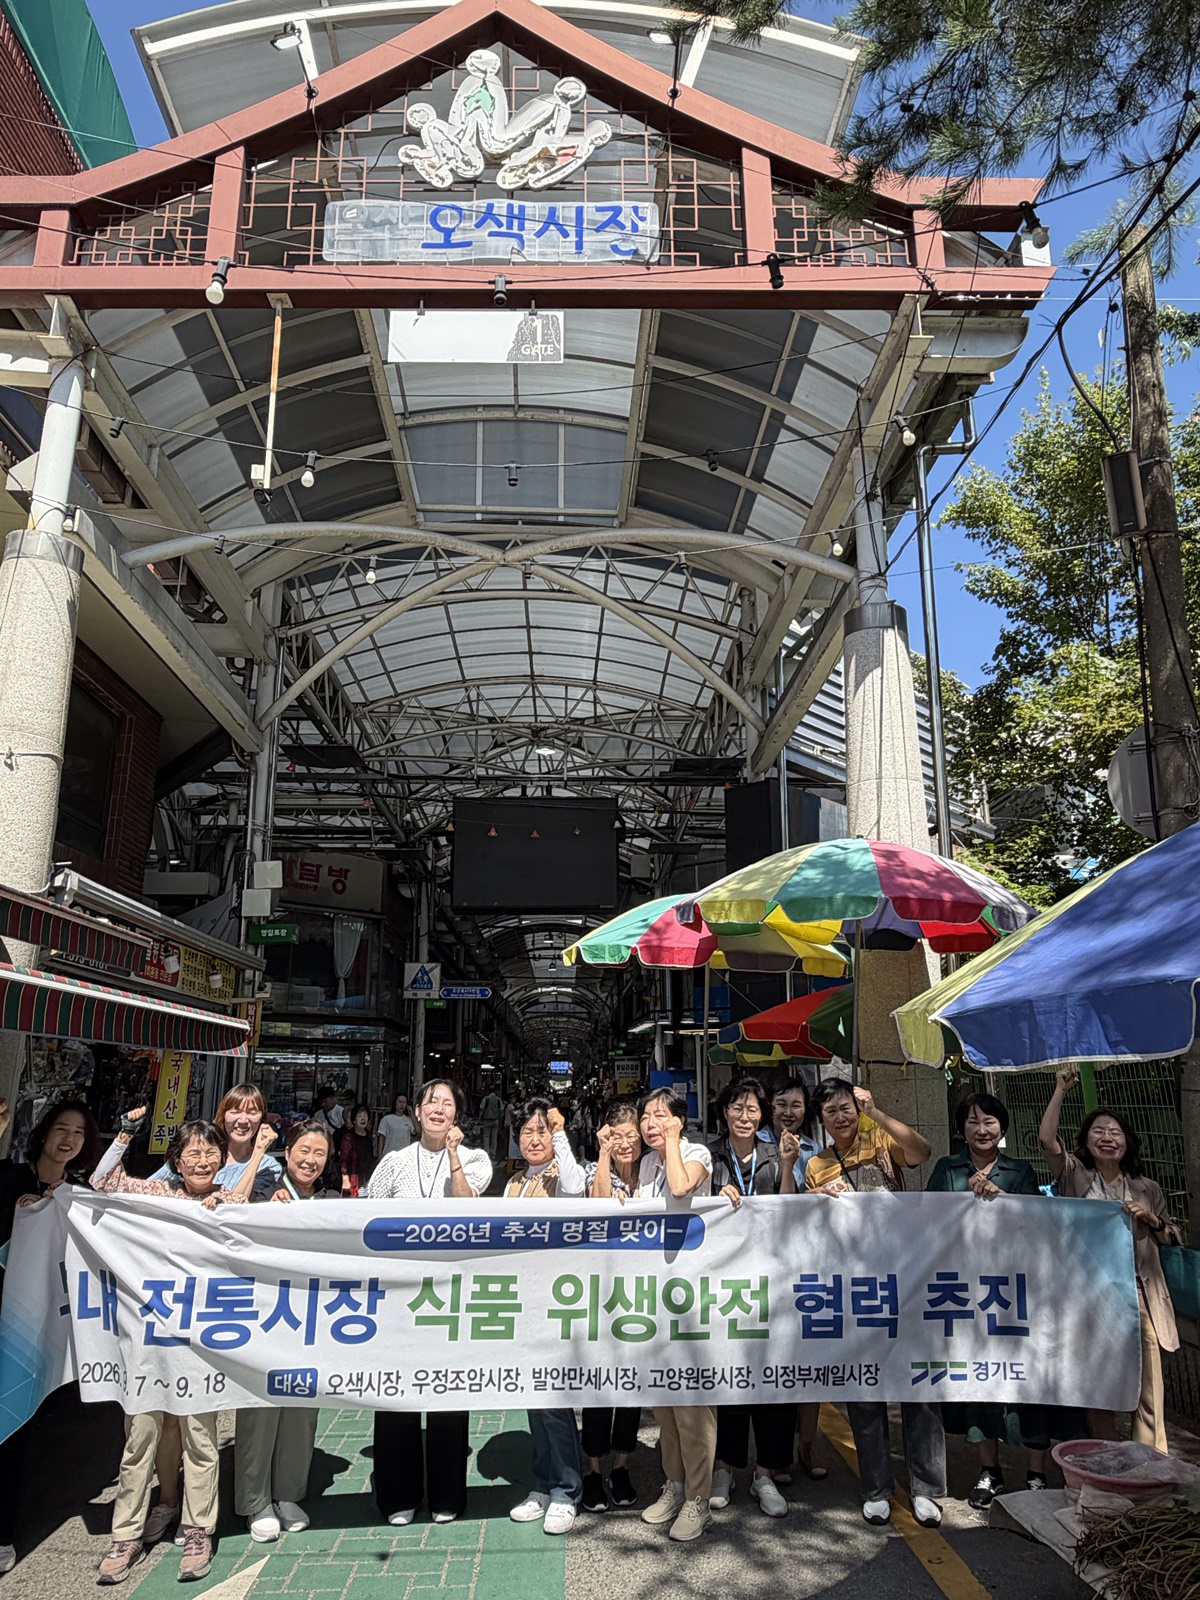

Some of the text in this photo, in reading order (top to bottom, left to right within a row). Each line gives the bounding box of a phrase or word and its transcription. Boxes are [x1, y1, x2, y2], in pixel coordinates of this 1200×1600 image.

[421, 202, 648, 256] 오색시장
[521, 344, 554, 356] GATE
[163, 1052, 183, 1120] 국내산
[501, 1221, 551, 1243] 추석
[562, 1220, 609, 1243] 명절
[59, 1251, 1030, 1350] 내 전통시장 식품 위생안전 협력 추진
[273, 1363, 880, 1398] 대상 오색시장, 우정조암시장, 발안만세시장, 고양원당시장, 의정부제일시장
[972, 1361, 1028, 1382] 경기도
